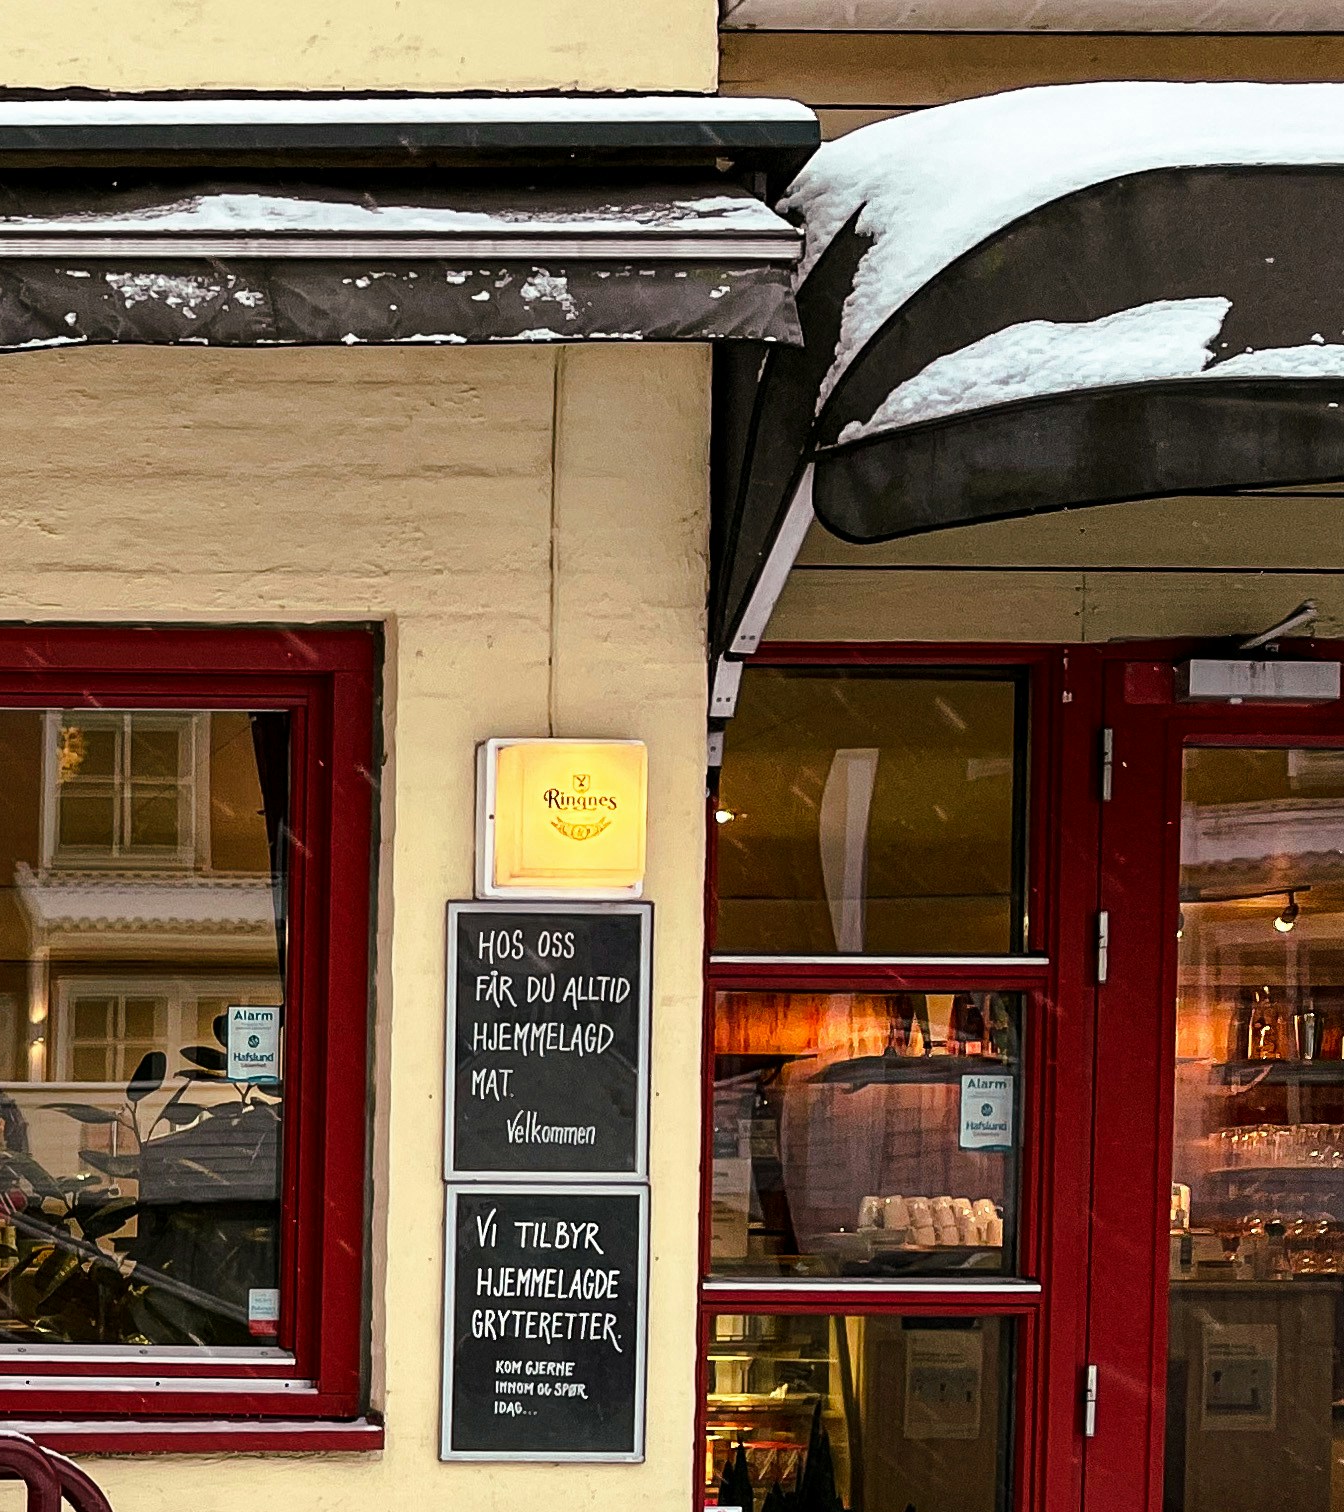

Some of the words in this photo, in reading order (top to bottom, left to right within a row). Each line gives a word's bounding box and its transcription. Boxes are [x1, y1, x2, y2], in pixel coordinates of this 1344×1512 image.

[543, 788, 617, 811] Ringnes
[478, 929, 525, 965] HOS
[537, 931, 576, 960] OSS
[475, 970, 518, 1008] FÅR
[526, 974, 556, 1004] DU
[562, 975, 631, 1011] ALLTID
[234, 1010, 273, 1021] Alarm
[472, 1021, 615, 1057] HJEMMELAGD
[233, 1053, 274, 1062] Hafslund
[967, 1078, 1007, 1089] Alarm
[506, 1109, 596, 1146] Velkommen
[513, 1221, 604, 1255] TILBYR
[476, 1267, 620, 1299] HJEMMELAGDE
[495, 1360, 522, 1375] KOM
[525, 1360, 575, 1377] GJERNE
[495, 1380, 534, 1396] INNOM
[537, 1381, 552, 1395] OG
[554, 1382, 589, 1400] SPØR
